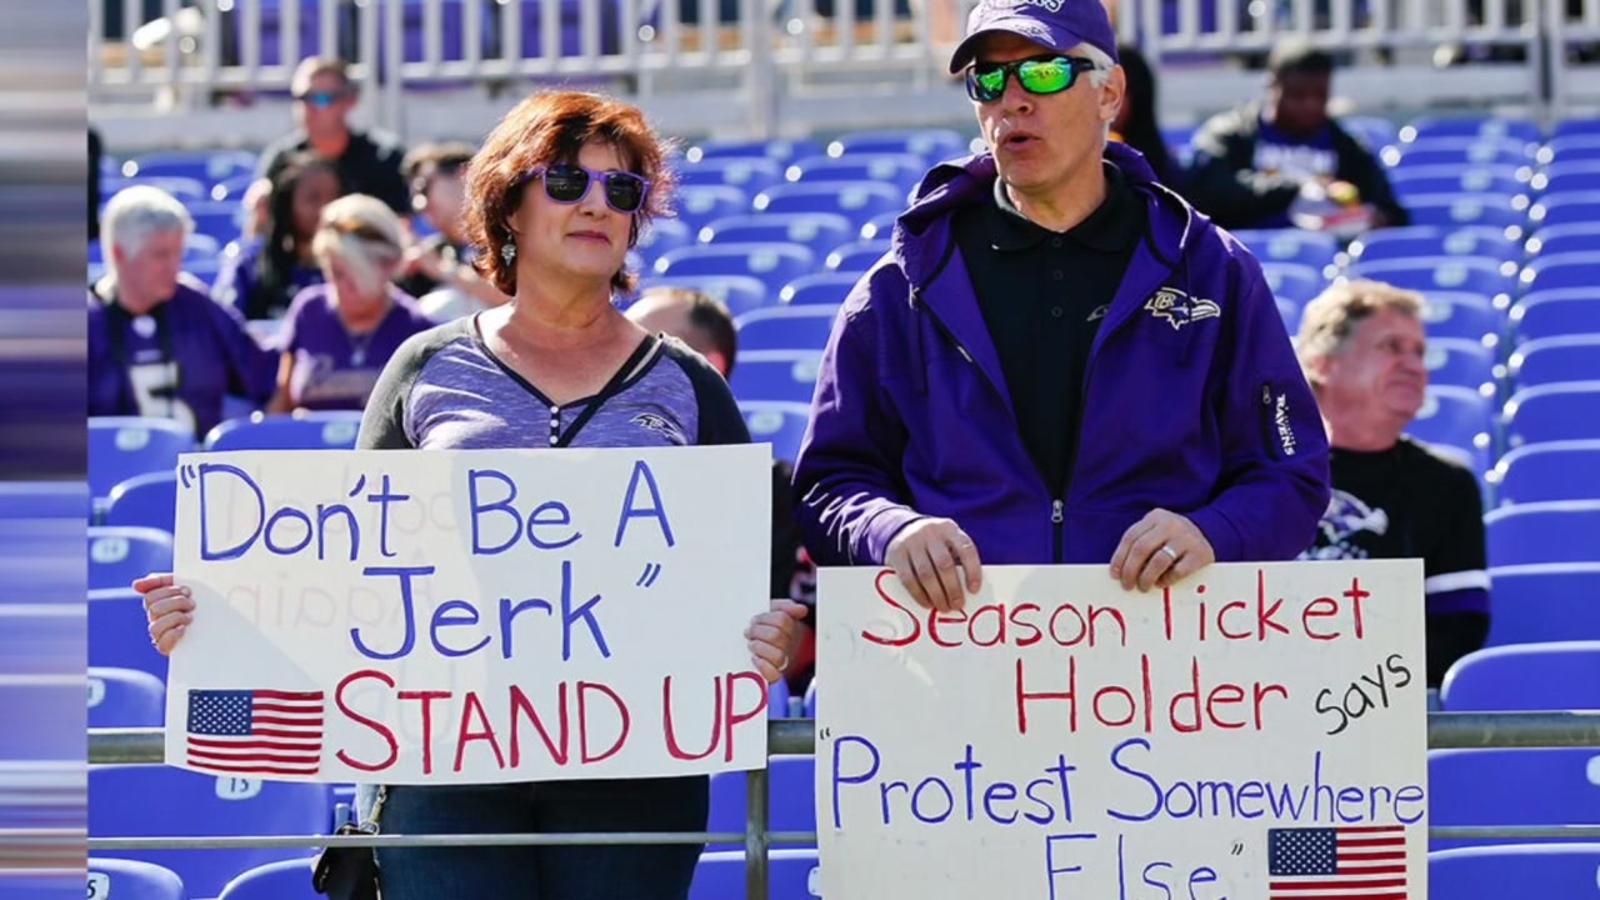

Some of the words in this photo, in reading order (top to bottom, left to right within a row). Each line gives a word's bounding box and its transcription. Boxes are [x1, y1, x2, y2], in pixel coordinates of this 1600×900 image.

[1275, 393, 1297, 456] RAVENS
[179, 463, 410, 561] "Don't
[468, 469, 583, 555] Be
[614, 460, 675, 547] A
[861, 569, 1126, 647] Season
[335, 669, 631, 775] STAND
[663, 671, 768, 764] UP
[1016, 654, 1288, 734] Holder
[1315, 653, 1412, 736] says
[1107, 738, 1425, 826] Somewhere
